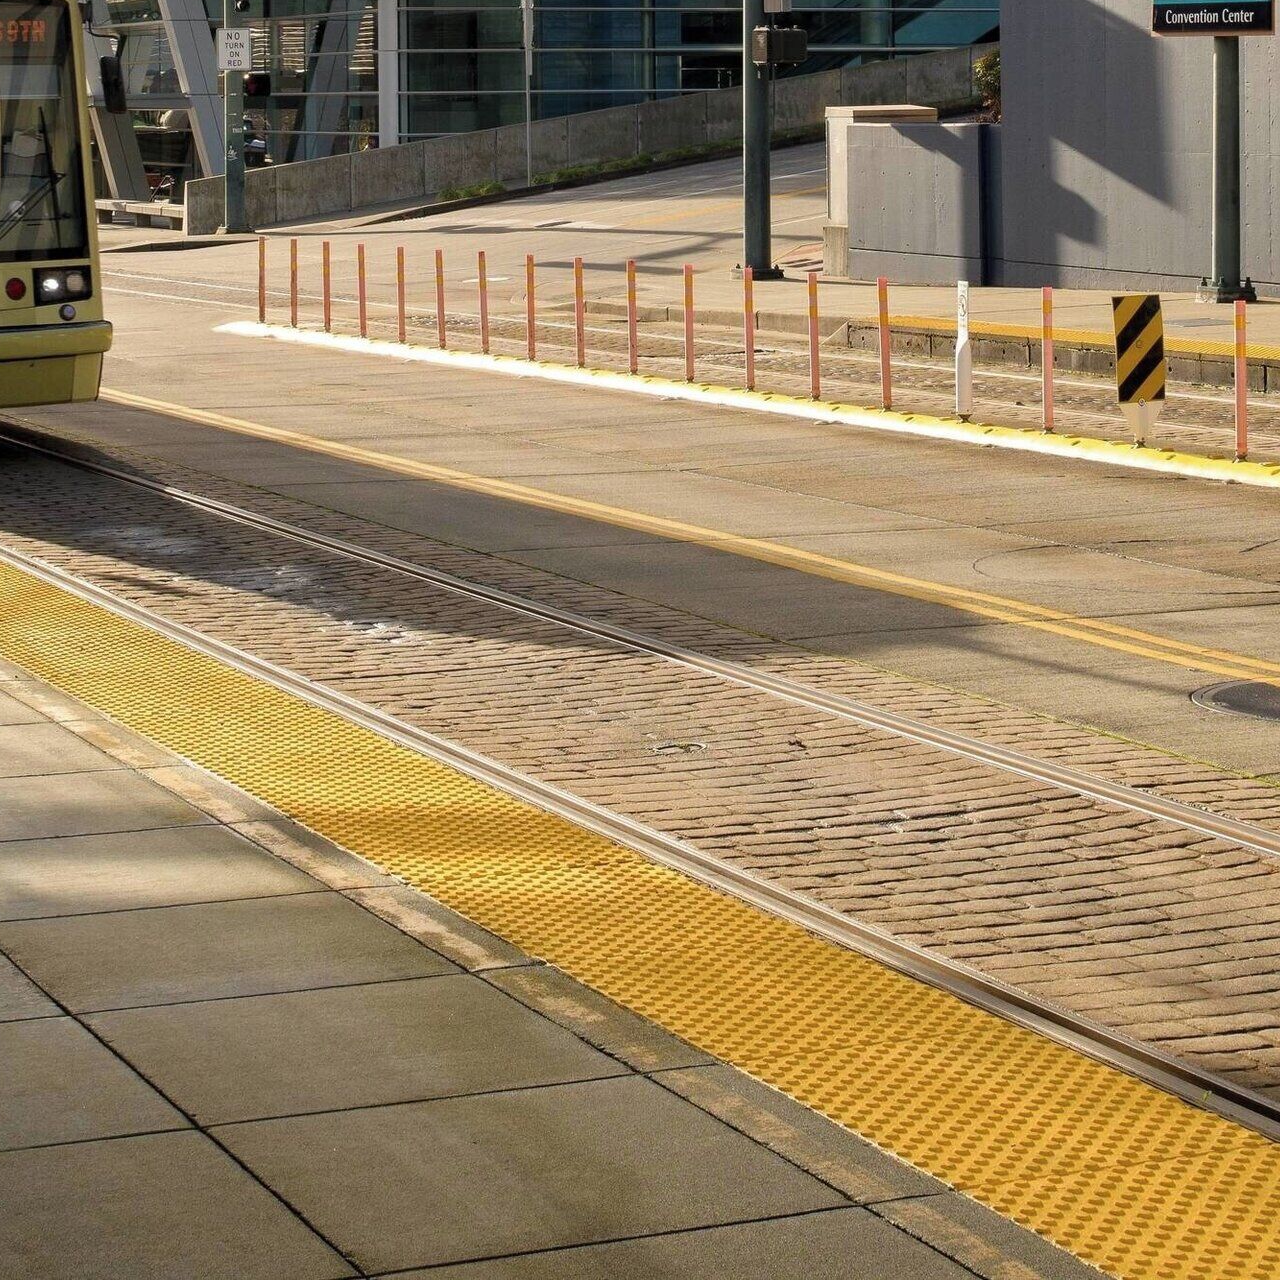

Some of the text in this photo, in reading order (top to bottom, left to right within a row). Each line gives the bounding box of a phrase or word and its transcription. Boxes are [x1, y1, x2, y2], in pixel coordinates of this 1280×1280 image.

[1165, 8, 1255, 24] Convention Center
[7, 20, 46, 43] 9TH
[226, 32, 241, 41] NO
